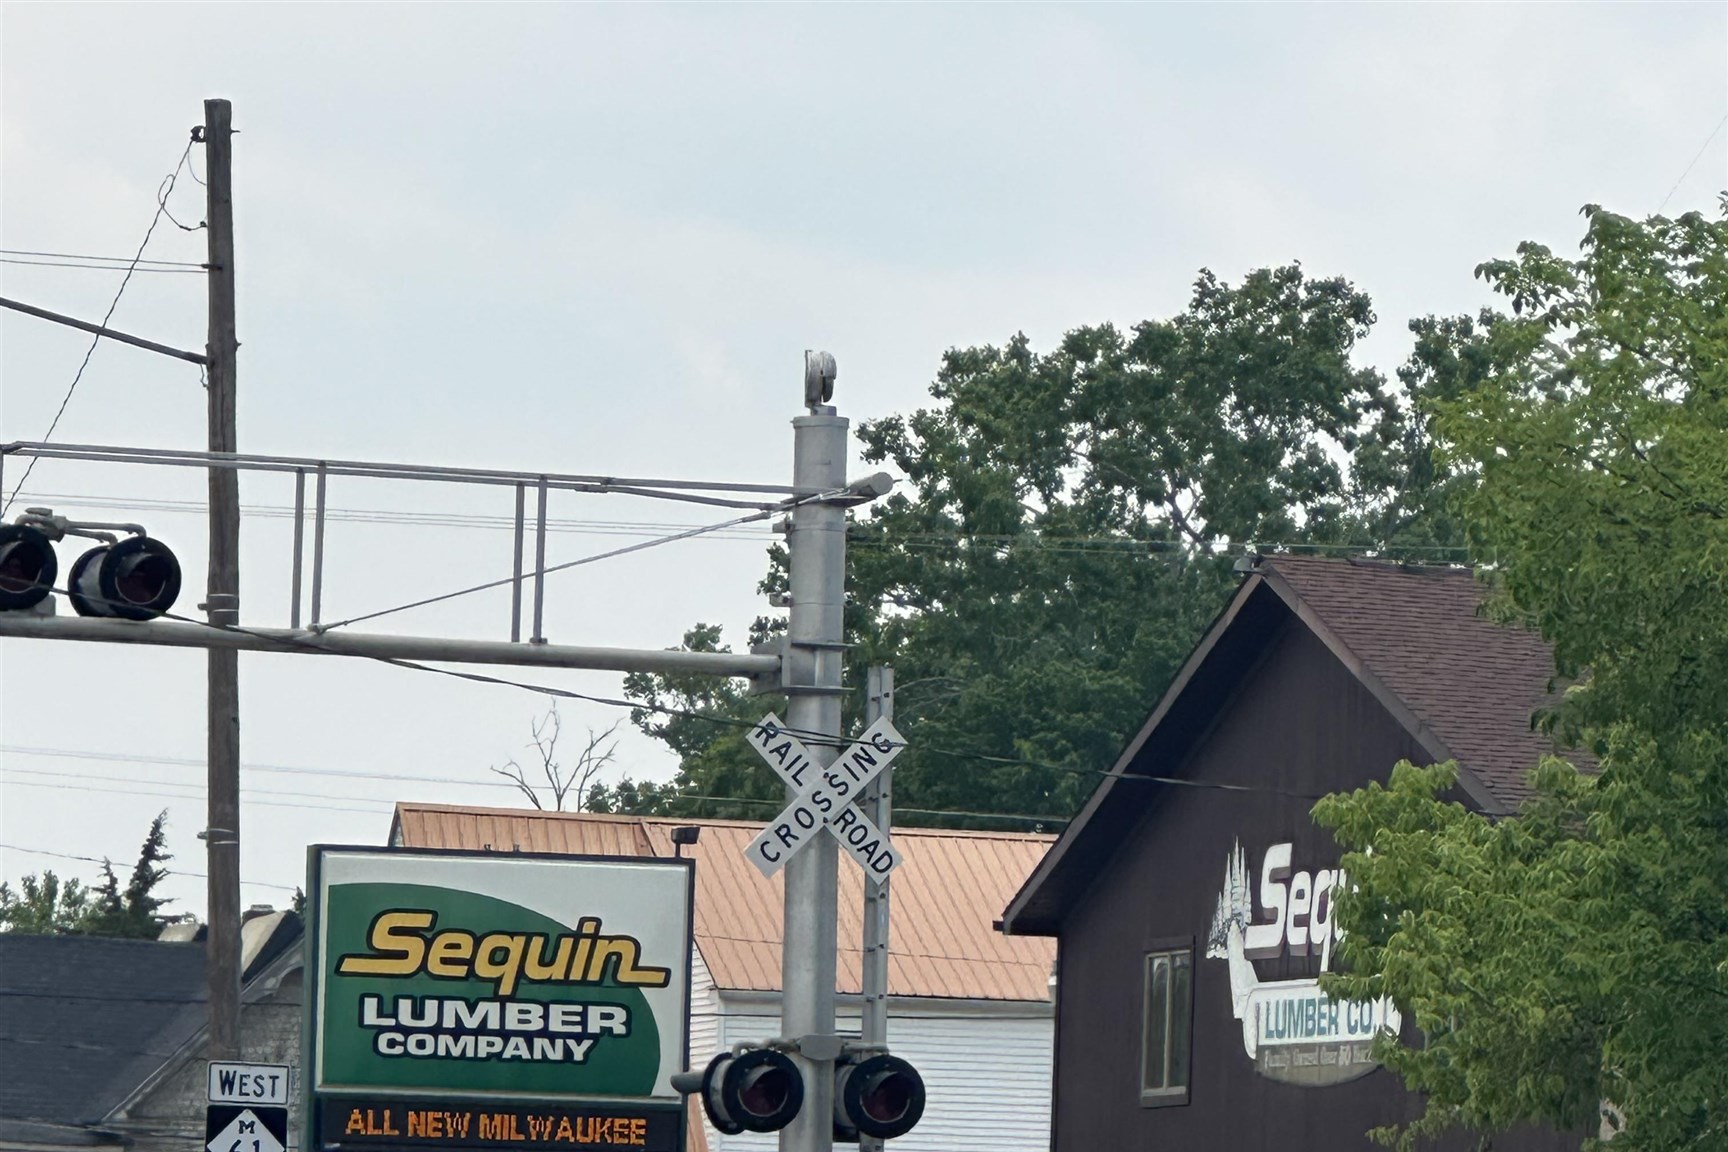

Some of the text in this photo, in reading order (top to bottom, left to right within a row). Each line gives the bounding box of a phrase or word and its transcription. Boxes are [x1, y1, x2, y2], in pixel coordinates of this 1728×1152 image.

[754, 721, 810, 787] RAIL
[760, 732, 893, 863] CROSSING
[833, 808, 894, 874] ROAD
[1244, 842, 1348, 972] Seq
[336, 908, 672, 998] Sequin
[362, 997, 629, 1035] LUMBER
[1264, 998, 1339, 1040] LUMBER
[377, 1032, 594, 1062] COMPANY
[219, 1069, 280, 1098] WEST
[238, 1120, 255, 1134] M
[345, 1109, 647, 1146] ALL NEW MILWAUKEE
